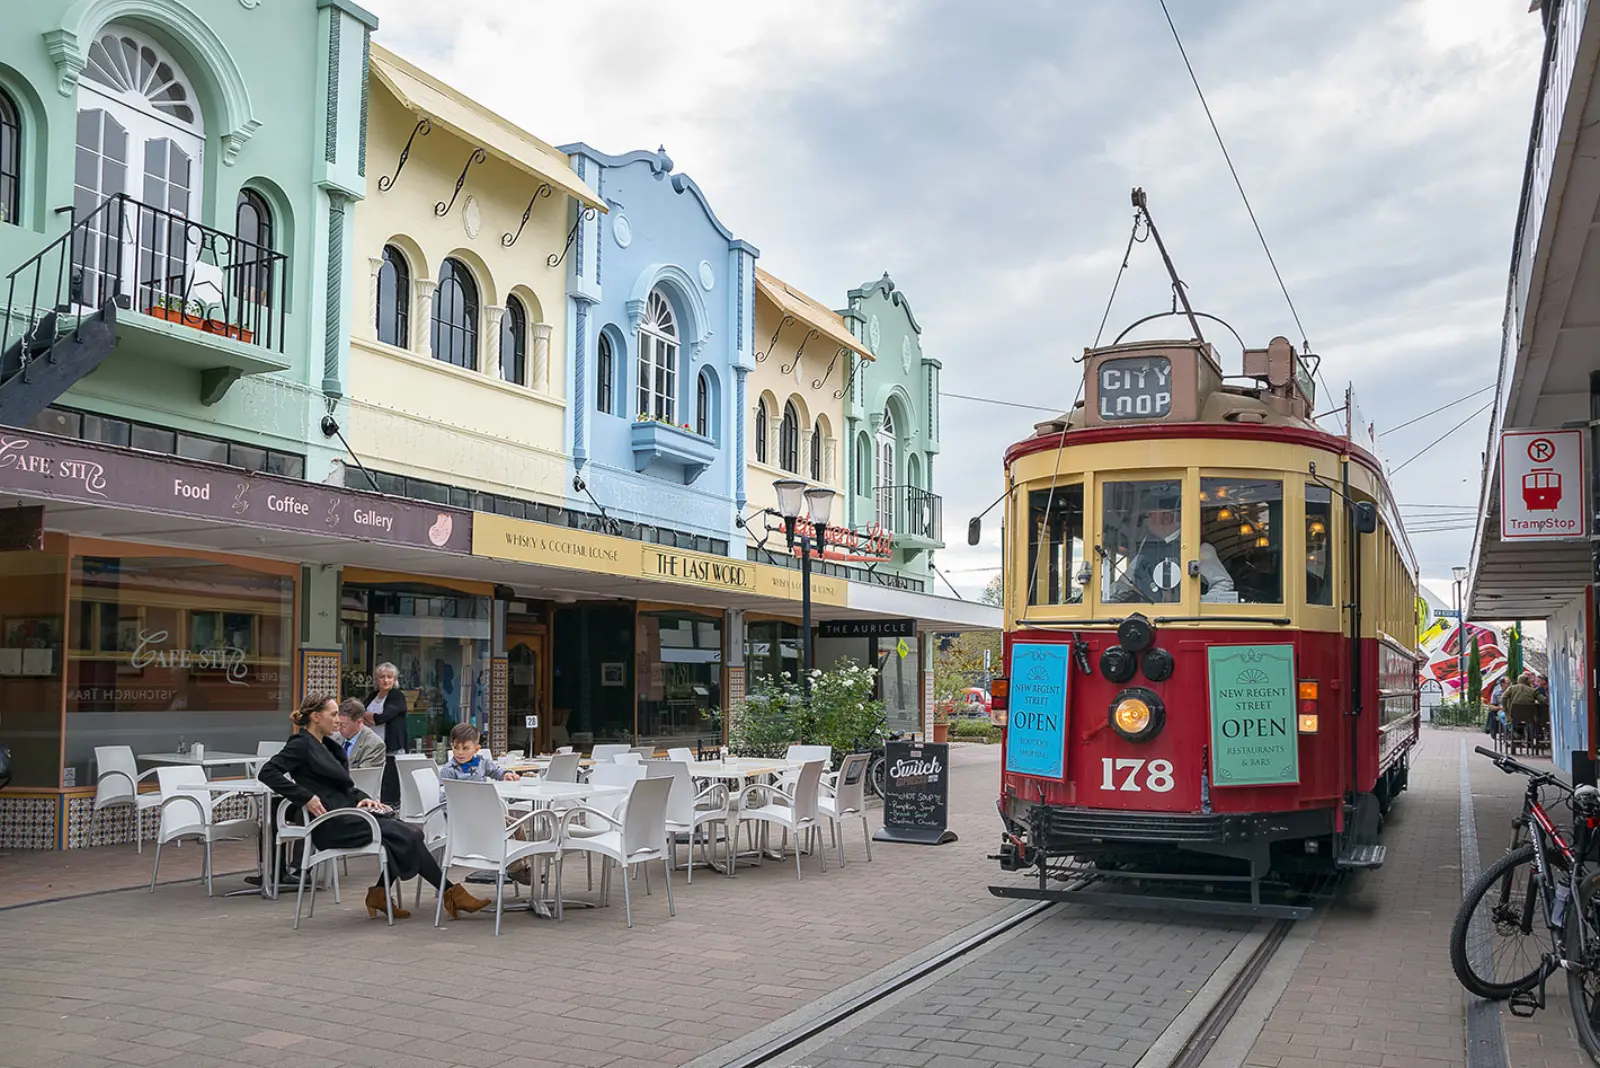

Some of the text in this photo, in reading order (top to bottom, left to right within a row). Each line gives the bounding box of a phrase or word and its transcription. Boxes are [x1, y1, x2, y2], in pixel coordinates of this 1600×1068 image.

[1103, 365, 1171, 389] CITY
[1101, 392, 1170, 416] LOOP
[59, 459, 109, 500] STIR
[174, 479, 393, 532] Food Coffee Gallery
[505, 532, 619, 562] WHISKY & COCKTAIL LOUNGE
[656, 553, 678, 577] THE
[683, 558, 710, 581] LAST
[825, 623, 906, 634] THE AURICLE
[131, 628, 251, 688] CAFE STIR
[1015, 683, 1060, 695] NEW REGENT
[1219, 687, 1287, 699] NEW REGENT
[1024, 695, 1049, 706] STREET
[1235, 701, 1272, 711] STREET
[527, 716, 537, 726] 28
[1014, 711, 1058, 732] OPEN
[1222, 718, 1287, 739] OPEN
[1227, 745, 1285, 756] RESTAURANTS
[889, 756, 942, 778] Switch
[1241, 758, 1271, 767] & BARS
[1100, 757, 1175, 793] 178
